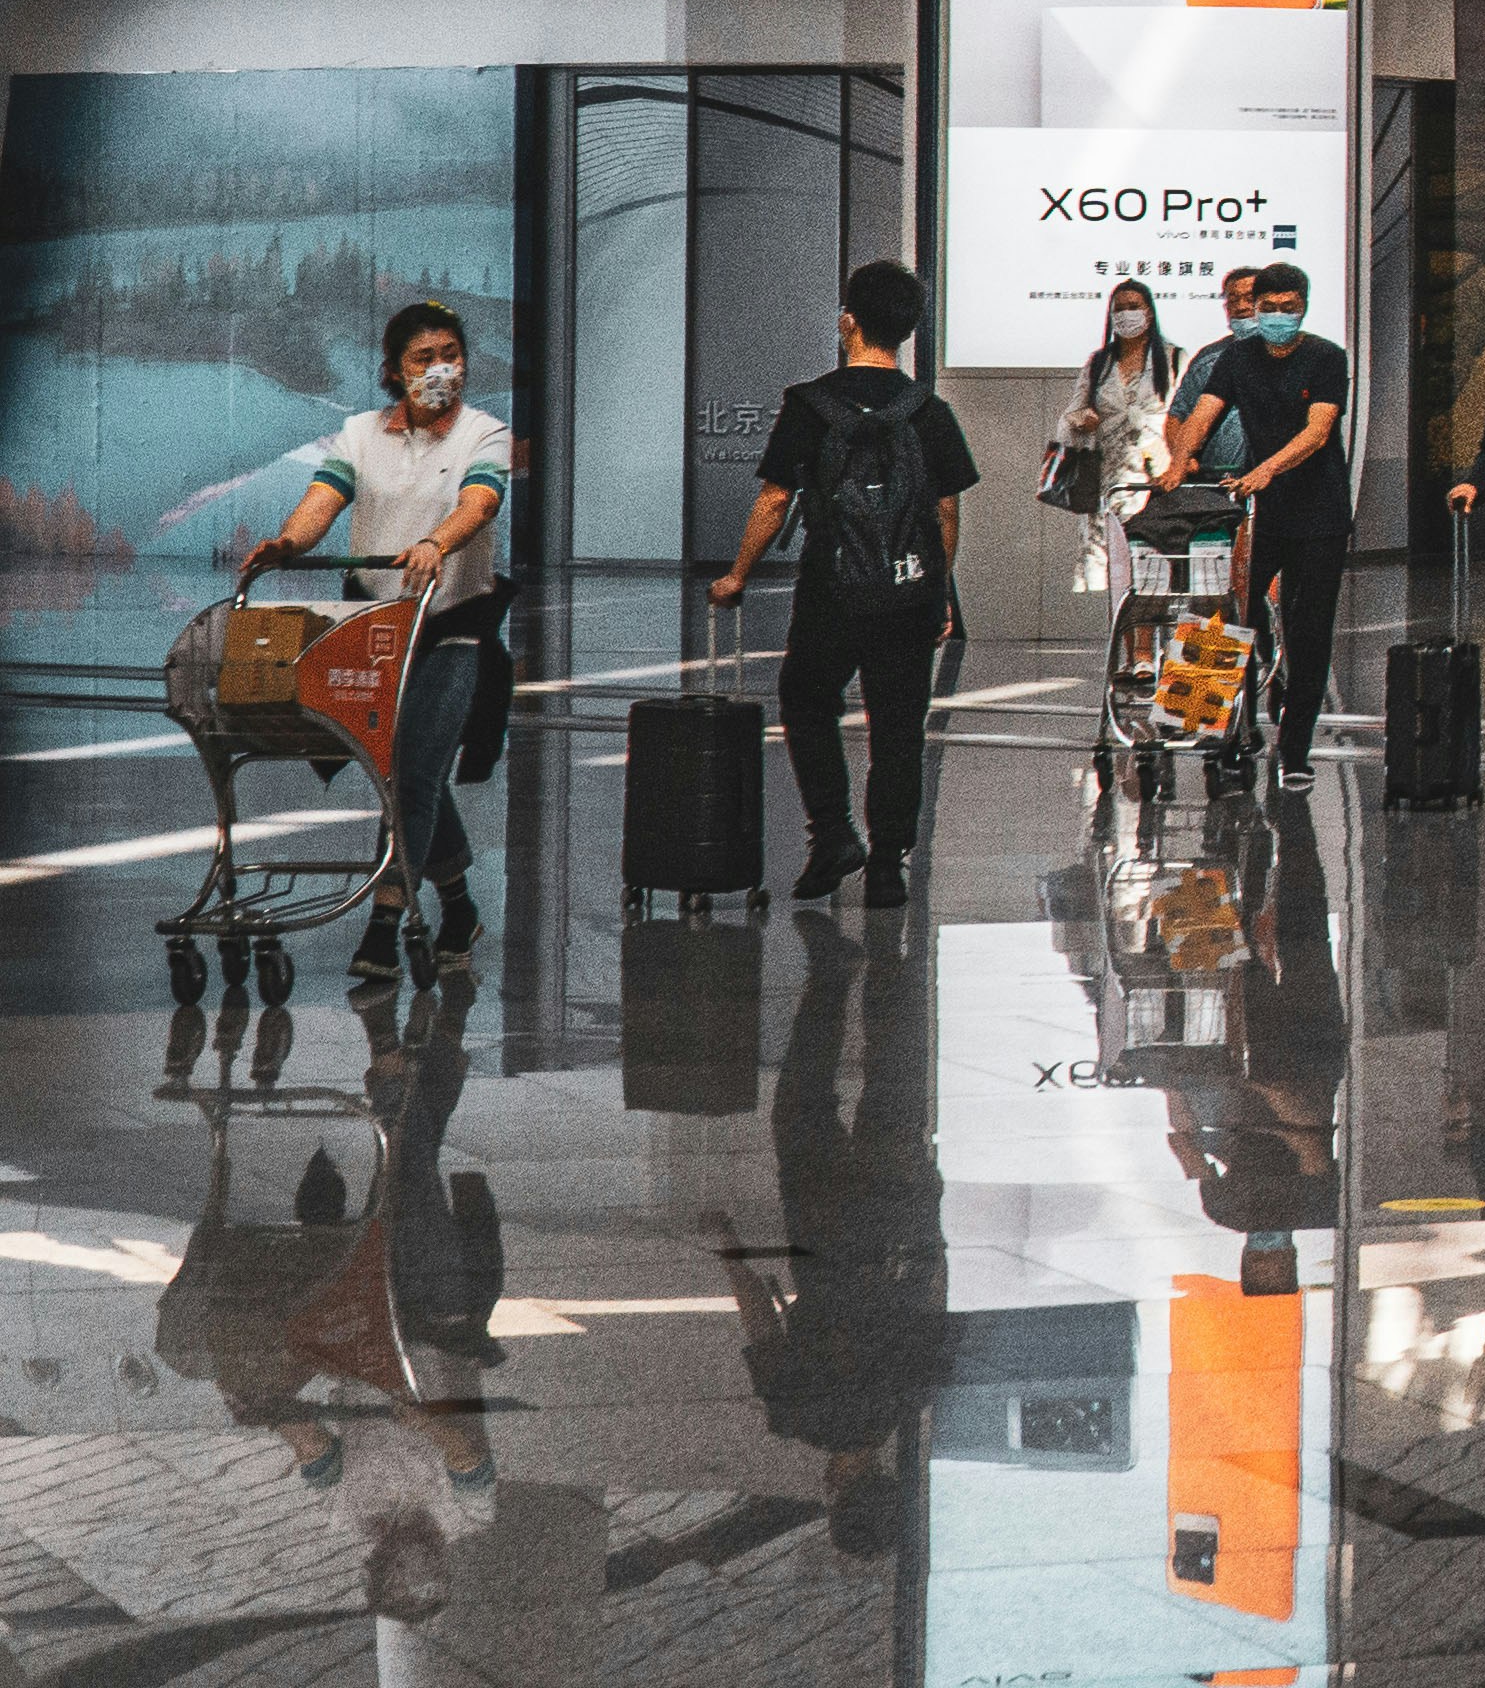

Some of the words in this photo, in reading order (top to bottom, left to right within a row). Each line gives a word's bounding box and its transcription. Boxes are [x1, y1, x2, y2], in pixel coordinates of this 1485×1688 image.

[1040, 188, 1147, 222] X60
[1162, 189, 1268, 223] Pro+
[1093, 260, 1215, 277] 专业影像旗舰
